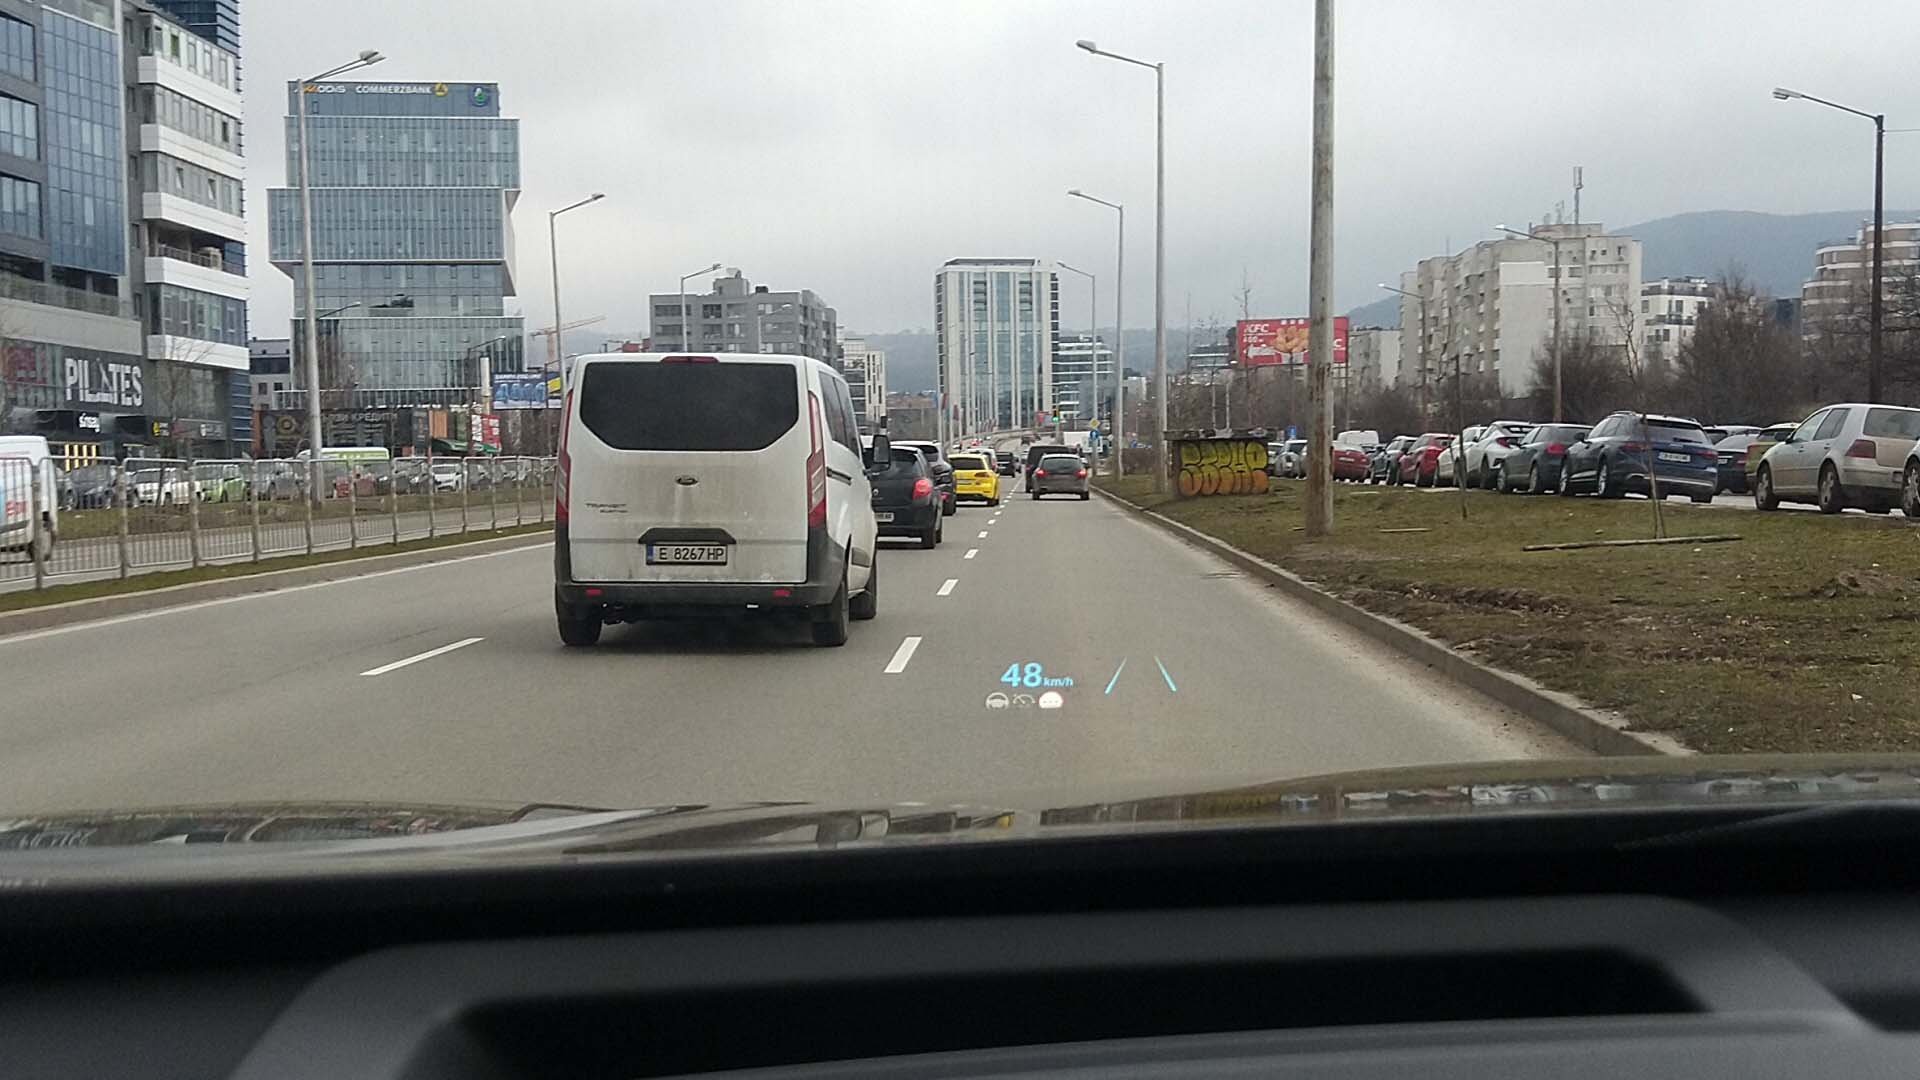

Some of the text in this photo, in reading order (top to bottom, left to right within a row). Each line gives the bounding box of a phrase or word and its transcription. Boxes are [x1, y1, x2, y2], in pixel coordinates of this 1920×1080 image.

[355, 85, 432, 94] COMMERZBANK
[1244, 324, 1269, 333] KFC
[65, 358, 143, 407] PILATES
[659, 547, 724, 560] E 8267 HP
[1000, 662, 1073, 687] 48 km/h
